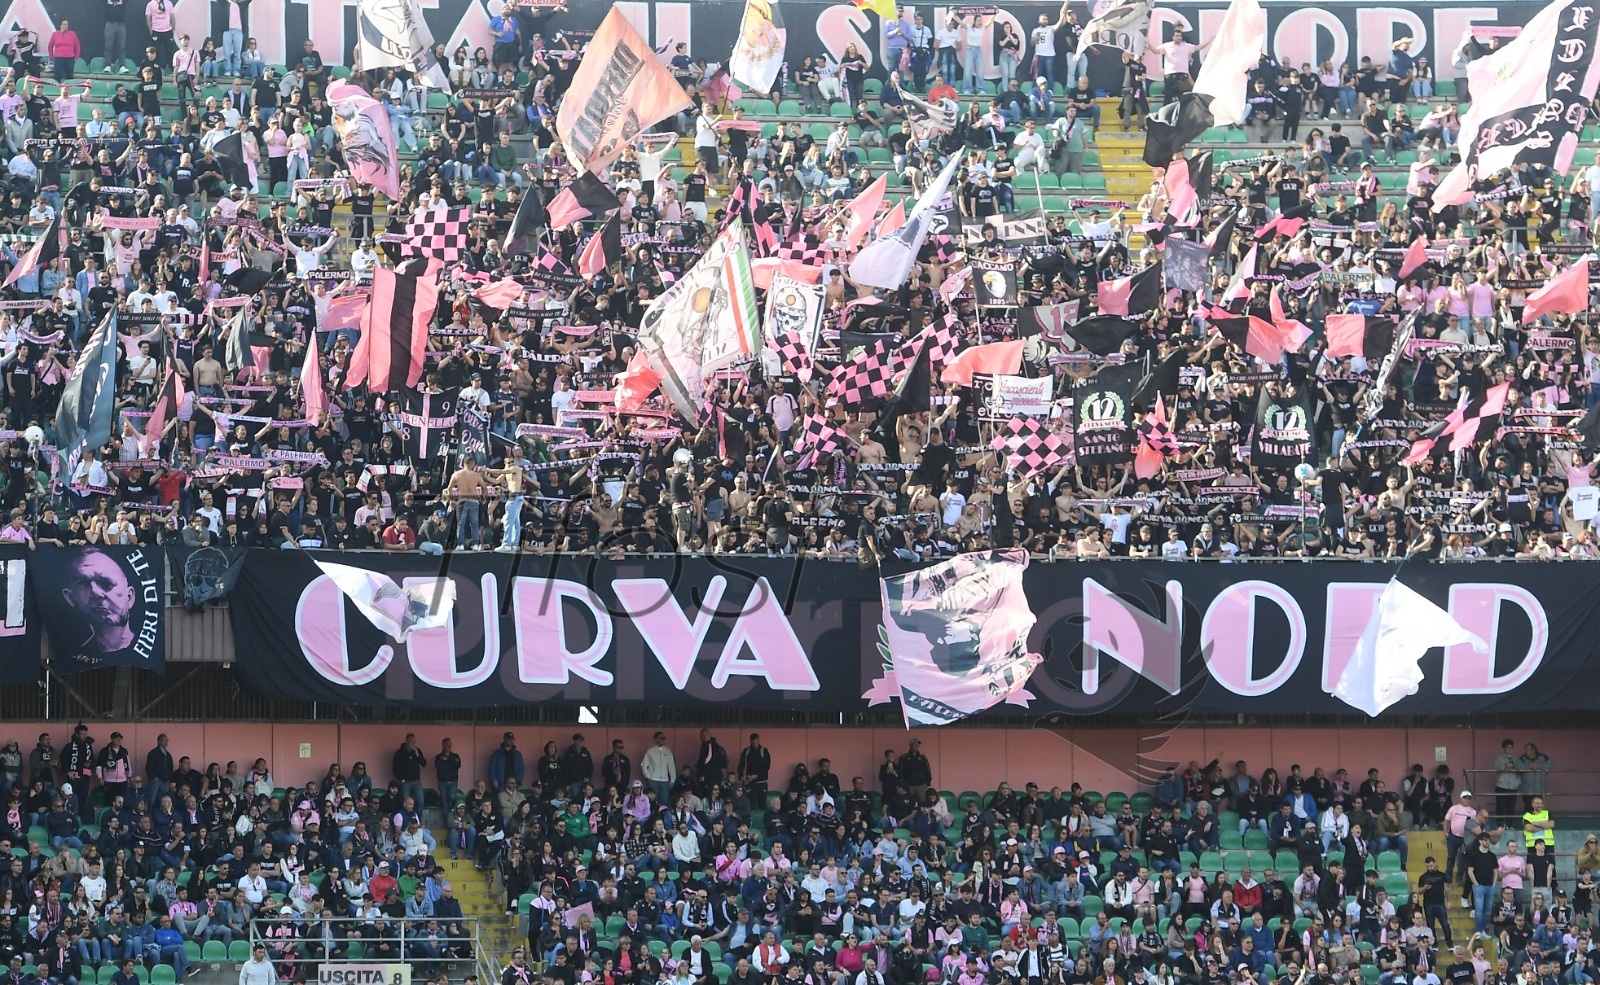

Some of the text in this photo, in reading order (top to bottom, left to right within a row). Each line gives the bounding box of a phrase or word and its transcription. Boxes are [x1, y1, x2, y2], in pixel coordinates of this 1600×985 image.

[189, 246, 237, 262] PAERMO
[309, 272, 349, 280] PALERMO
[1324, 273, 1372, 281] PALERMO
[1527, 338, 1575, 348] PALERMO
[522, 350, 572, 365] PALERMO
[442, 401, 450, 414] 9
[1091, 398, 1115, 421] 12
[403, 412, 456, 428] ARENELLA
[1275, 411, 1299, 431] 12
[402, 427, 410, 441] 8
[1084, 433, 1120, 444] SANTO
[1079, 444, 1129, 455] STEFANO
[1259, 441, 1312, 456] VILLABATE
[280, 451, 317, 460] PALERMO
[224, 458, 266, 468] PALERMO
[1425, 490, 1494, 499] PALERMO
[792, 517, 846, 527] ALERMO
[127, 549, 158, 660] FIERI DI TE
[294, 571, 821, 691] CURVA
[319, 970, 404, 985] USCITA 8
